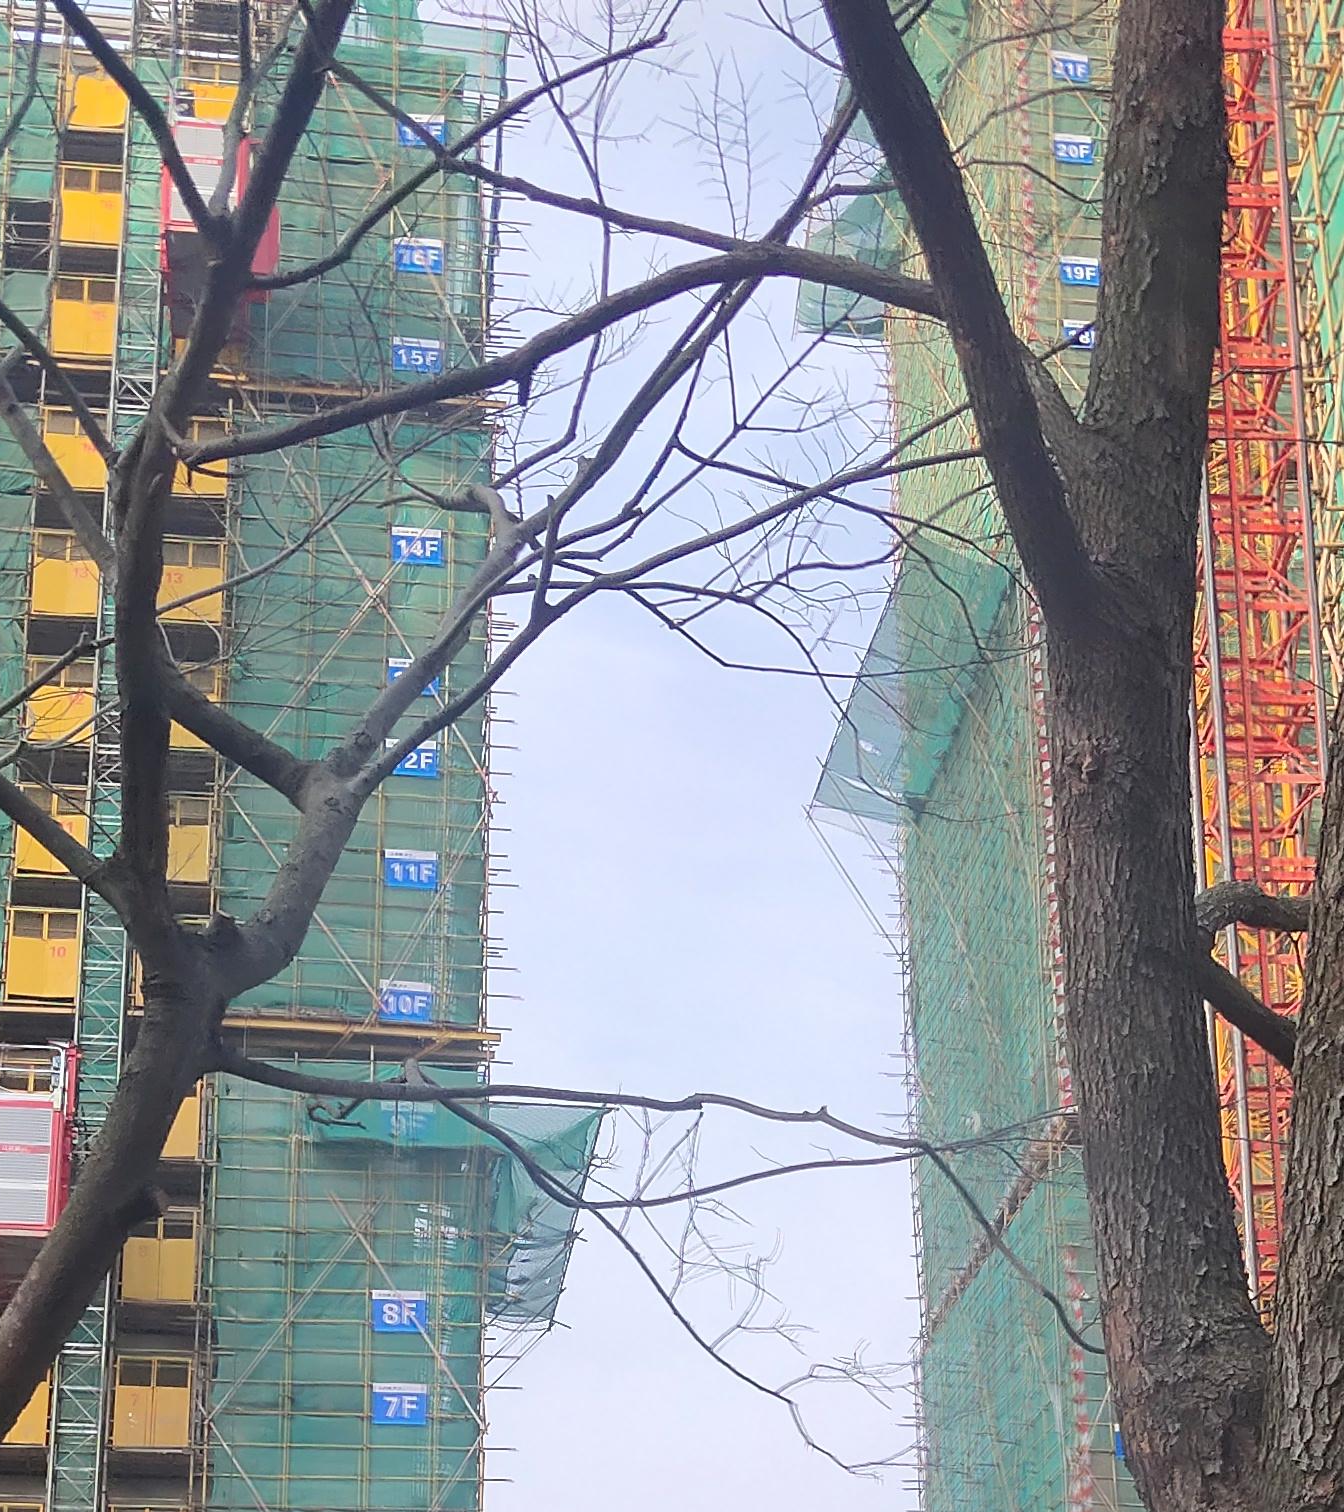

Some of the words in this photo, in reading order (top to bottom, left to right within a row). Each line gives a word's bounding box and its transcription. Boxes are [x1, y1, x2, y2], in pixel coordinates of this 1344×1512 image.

[1056, 143, 1090, 159] 20F
[399, 248, 439, 266] 16F
[1063, 266, 1096, 281] 19F
[398, 349, 438, 366] 15F
[397, 540, 438, 557] 14F
[396, 752, 433, 769] 2F
[390, 862, 433, 883] 11F
[384, 994, 428, 1015] 10F
[383, 1302, 417, 1325] 8F
[383, 1395, 418, 1418] 7F
